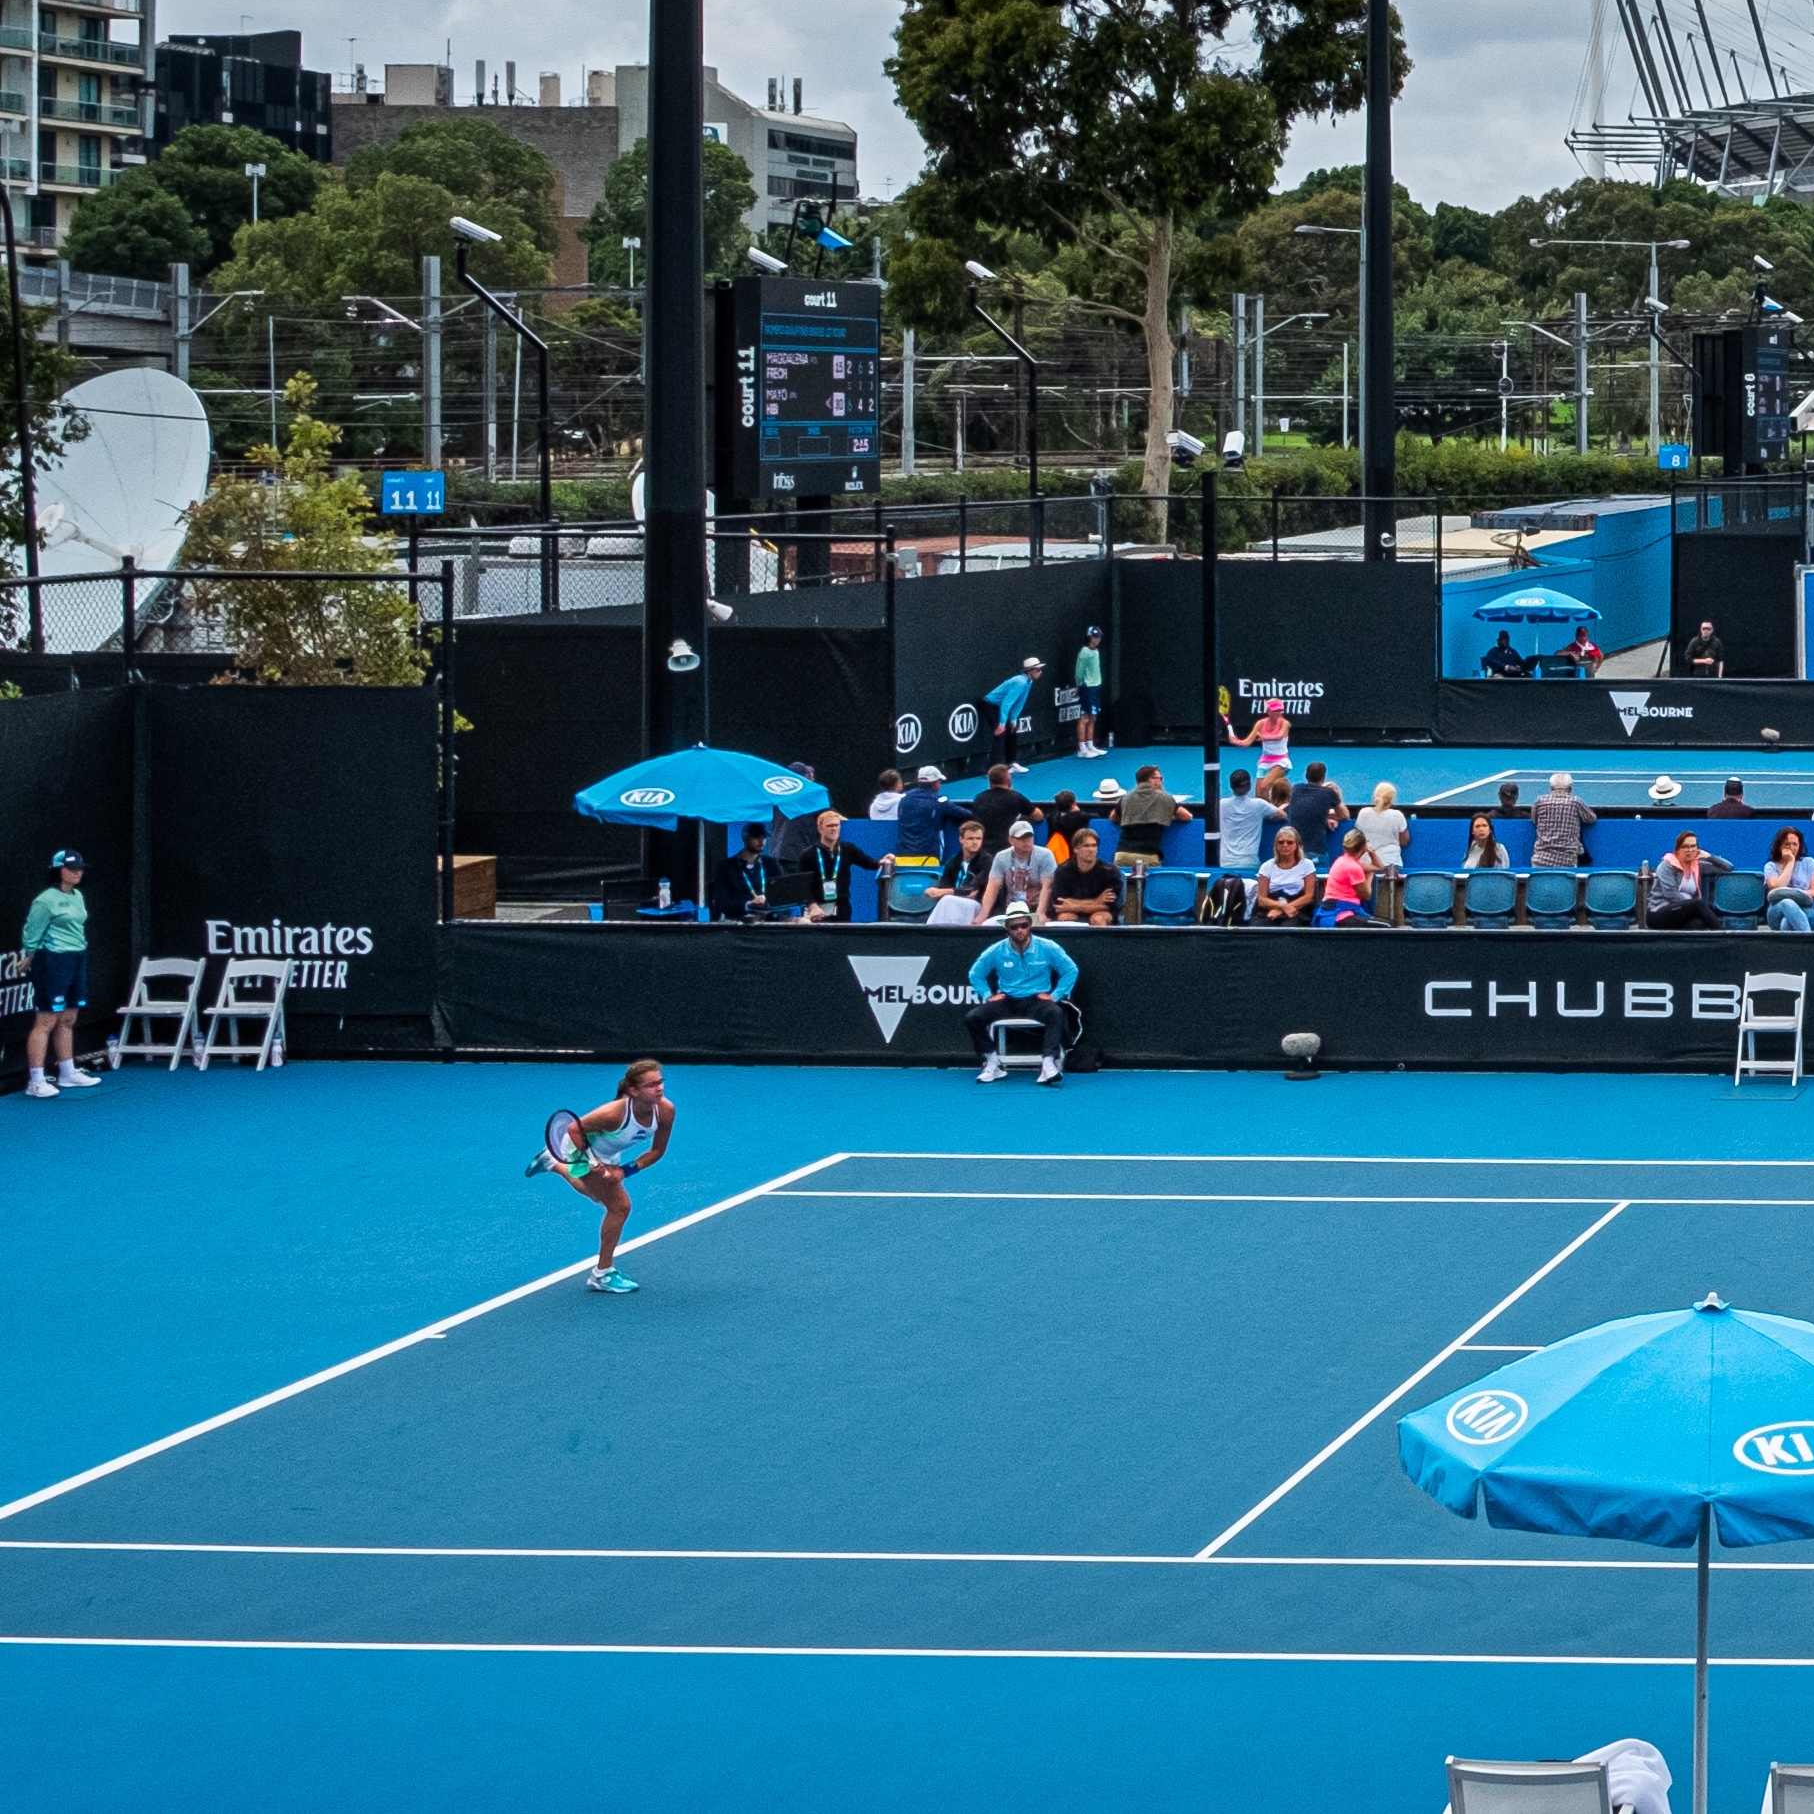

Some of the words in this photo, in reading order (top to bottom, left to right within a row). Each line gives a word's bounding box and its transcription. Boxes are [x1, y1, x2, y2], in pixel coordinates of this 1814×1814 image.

[826, 291, 838, 308] 11
[738, 346, 755, 372] 11
[740, 376, 755, 428] court
[1671, 455, 1681, 467] 8
[390, 490, 418, 510] 11
[426, 490, 442, 510] 11
[1238, 678, 1325, 698] Emirates
[1617, 706, 1694, 718] MELBOURNE
[205, 918, 374, 955] Emirates
[287, 960, 348, 988] ETTER
[863, 985, 988, 1005] MELBOUR
[1424, 981, 1742, 1020] CHUBB
